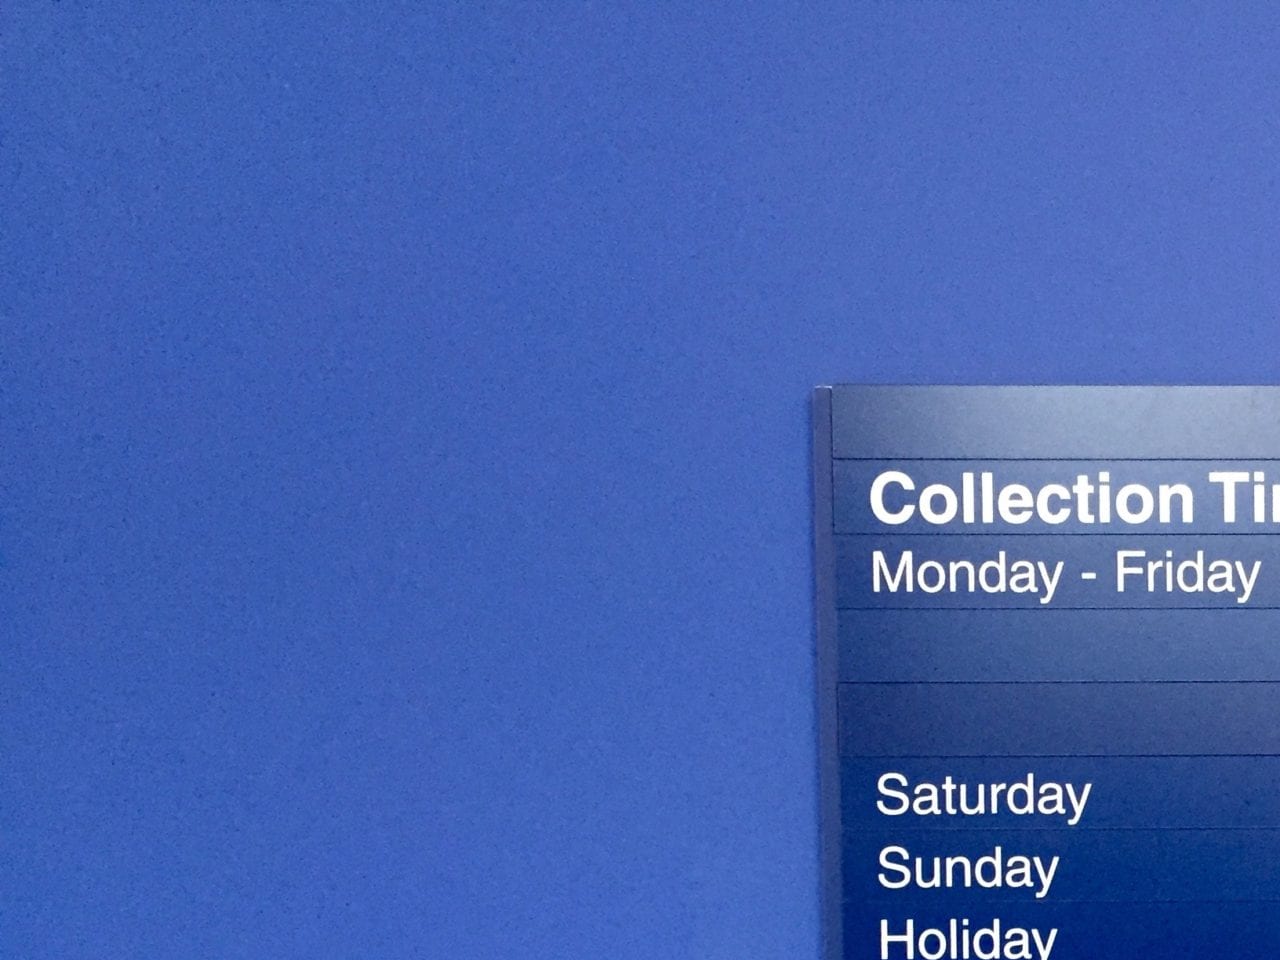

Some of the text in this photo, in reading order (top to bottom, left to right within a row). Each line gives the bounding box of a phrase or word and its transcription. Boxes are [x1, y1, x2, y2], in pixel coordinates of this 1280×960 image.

[869, 469, 1195, 526] Collection
[871, 549, 1066, 605] Monday
[1115, 549, 1263, 605] Friday
[875, 771, 1093, 826] Saturday
[877, 844, 1061, 899] Sunday
